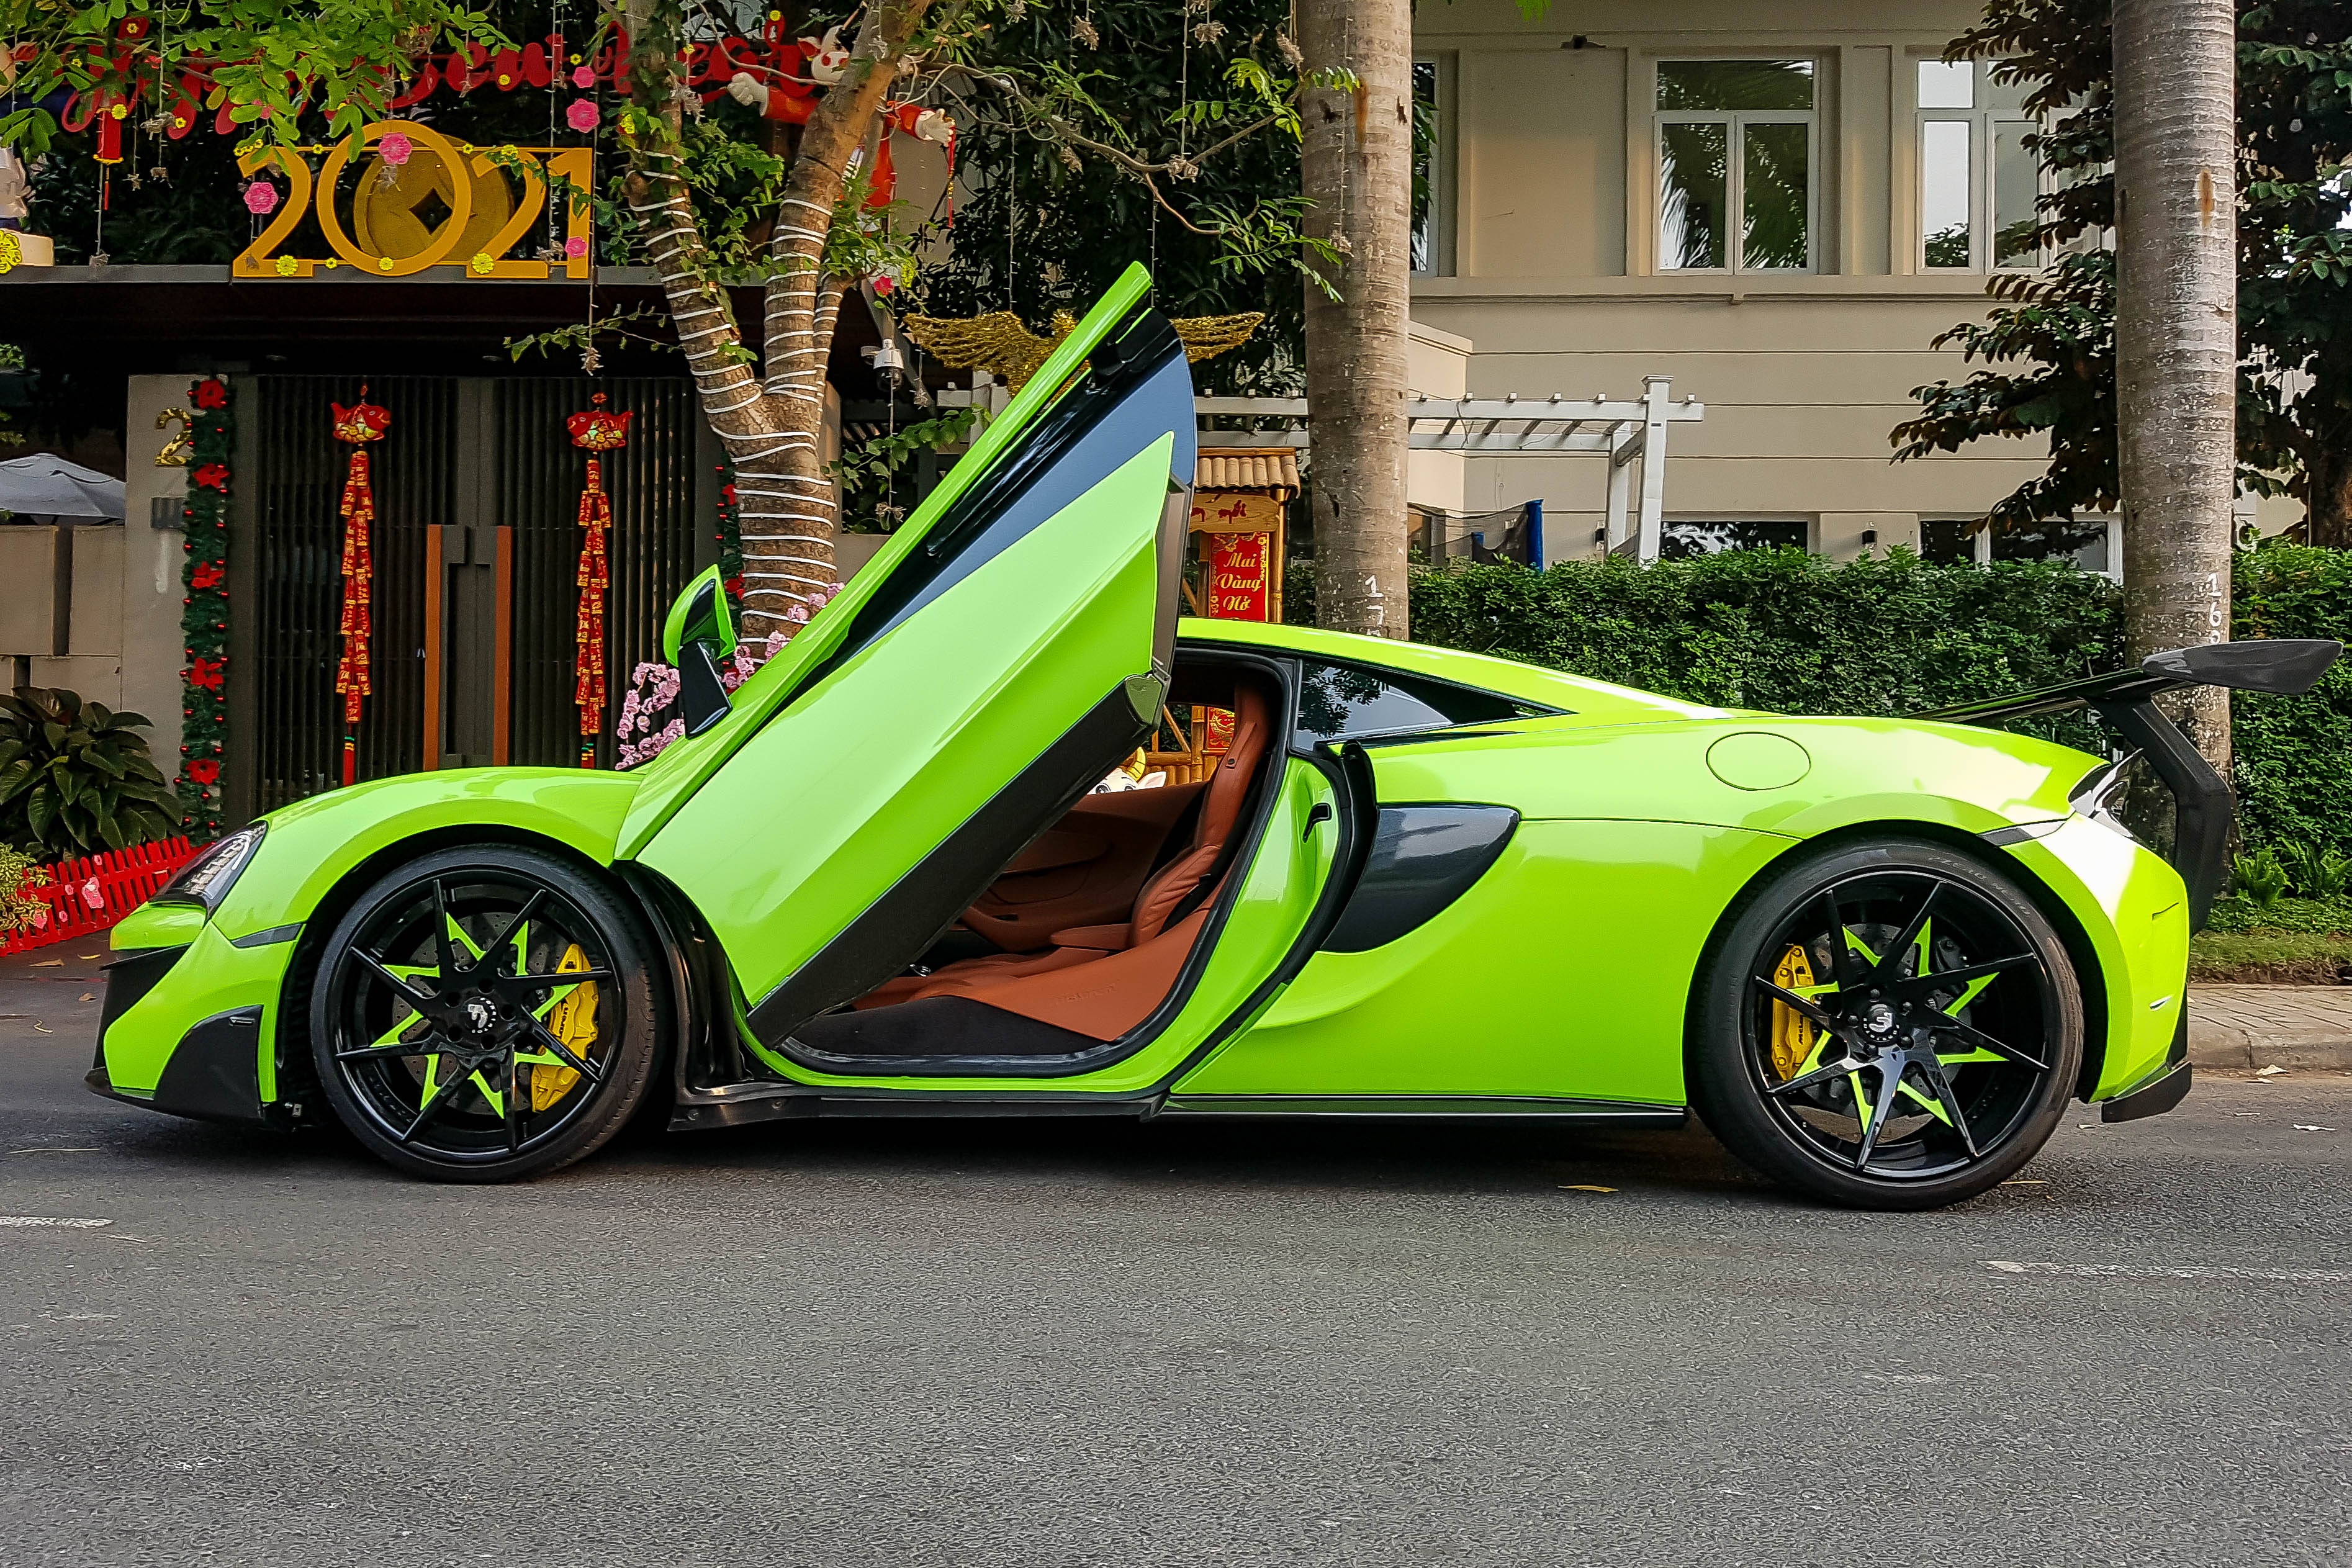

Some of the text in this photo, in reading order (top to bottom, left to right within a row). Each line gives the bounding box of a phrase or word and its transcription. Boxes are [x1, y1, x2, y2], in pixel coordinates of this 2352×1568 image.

[233, 120, 592, 279] 2021
[1223, 552, 1258, 568] Mai
[1215, 573, 1263, 592] Vàng
[1222, 595, 1251, 611] Nở
